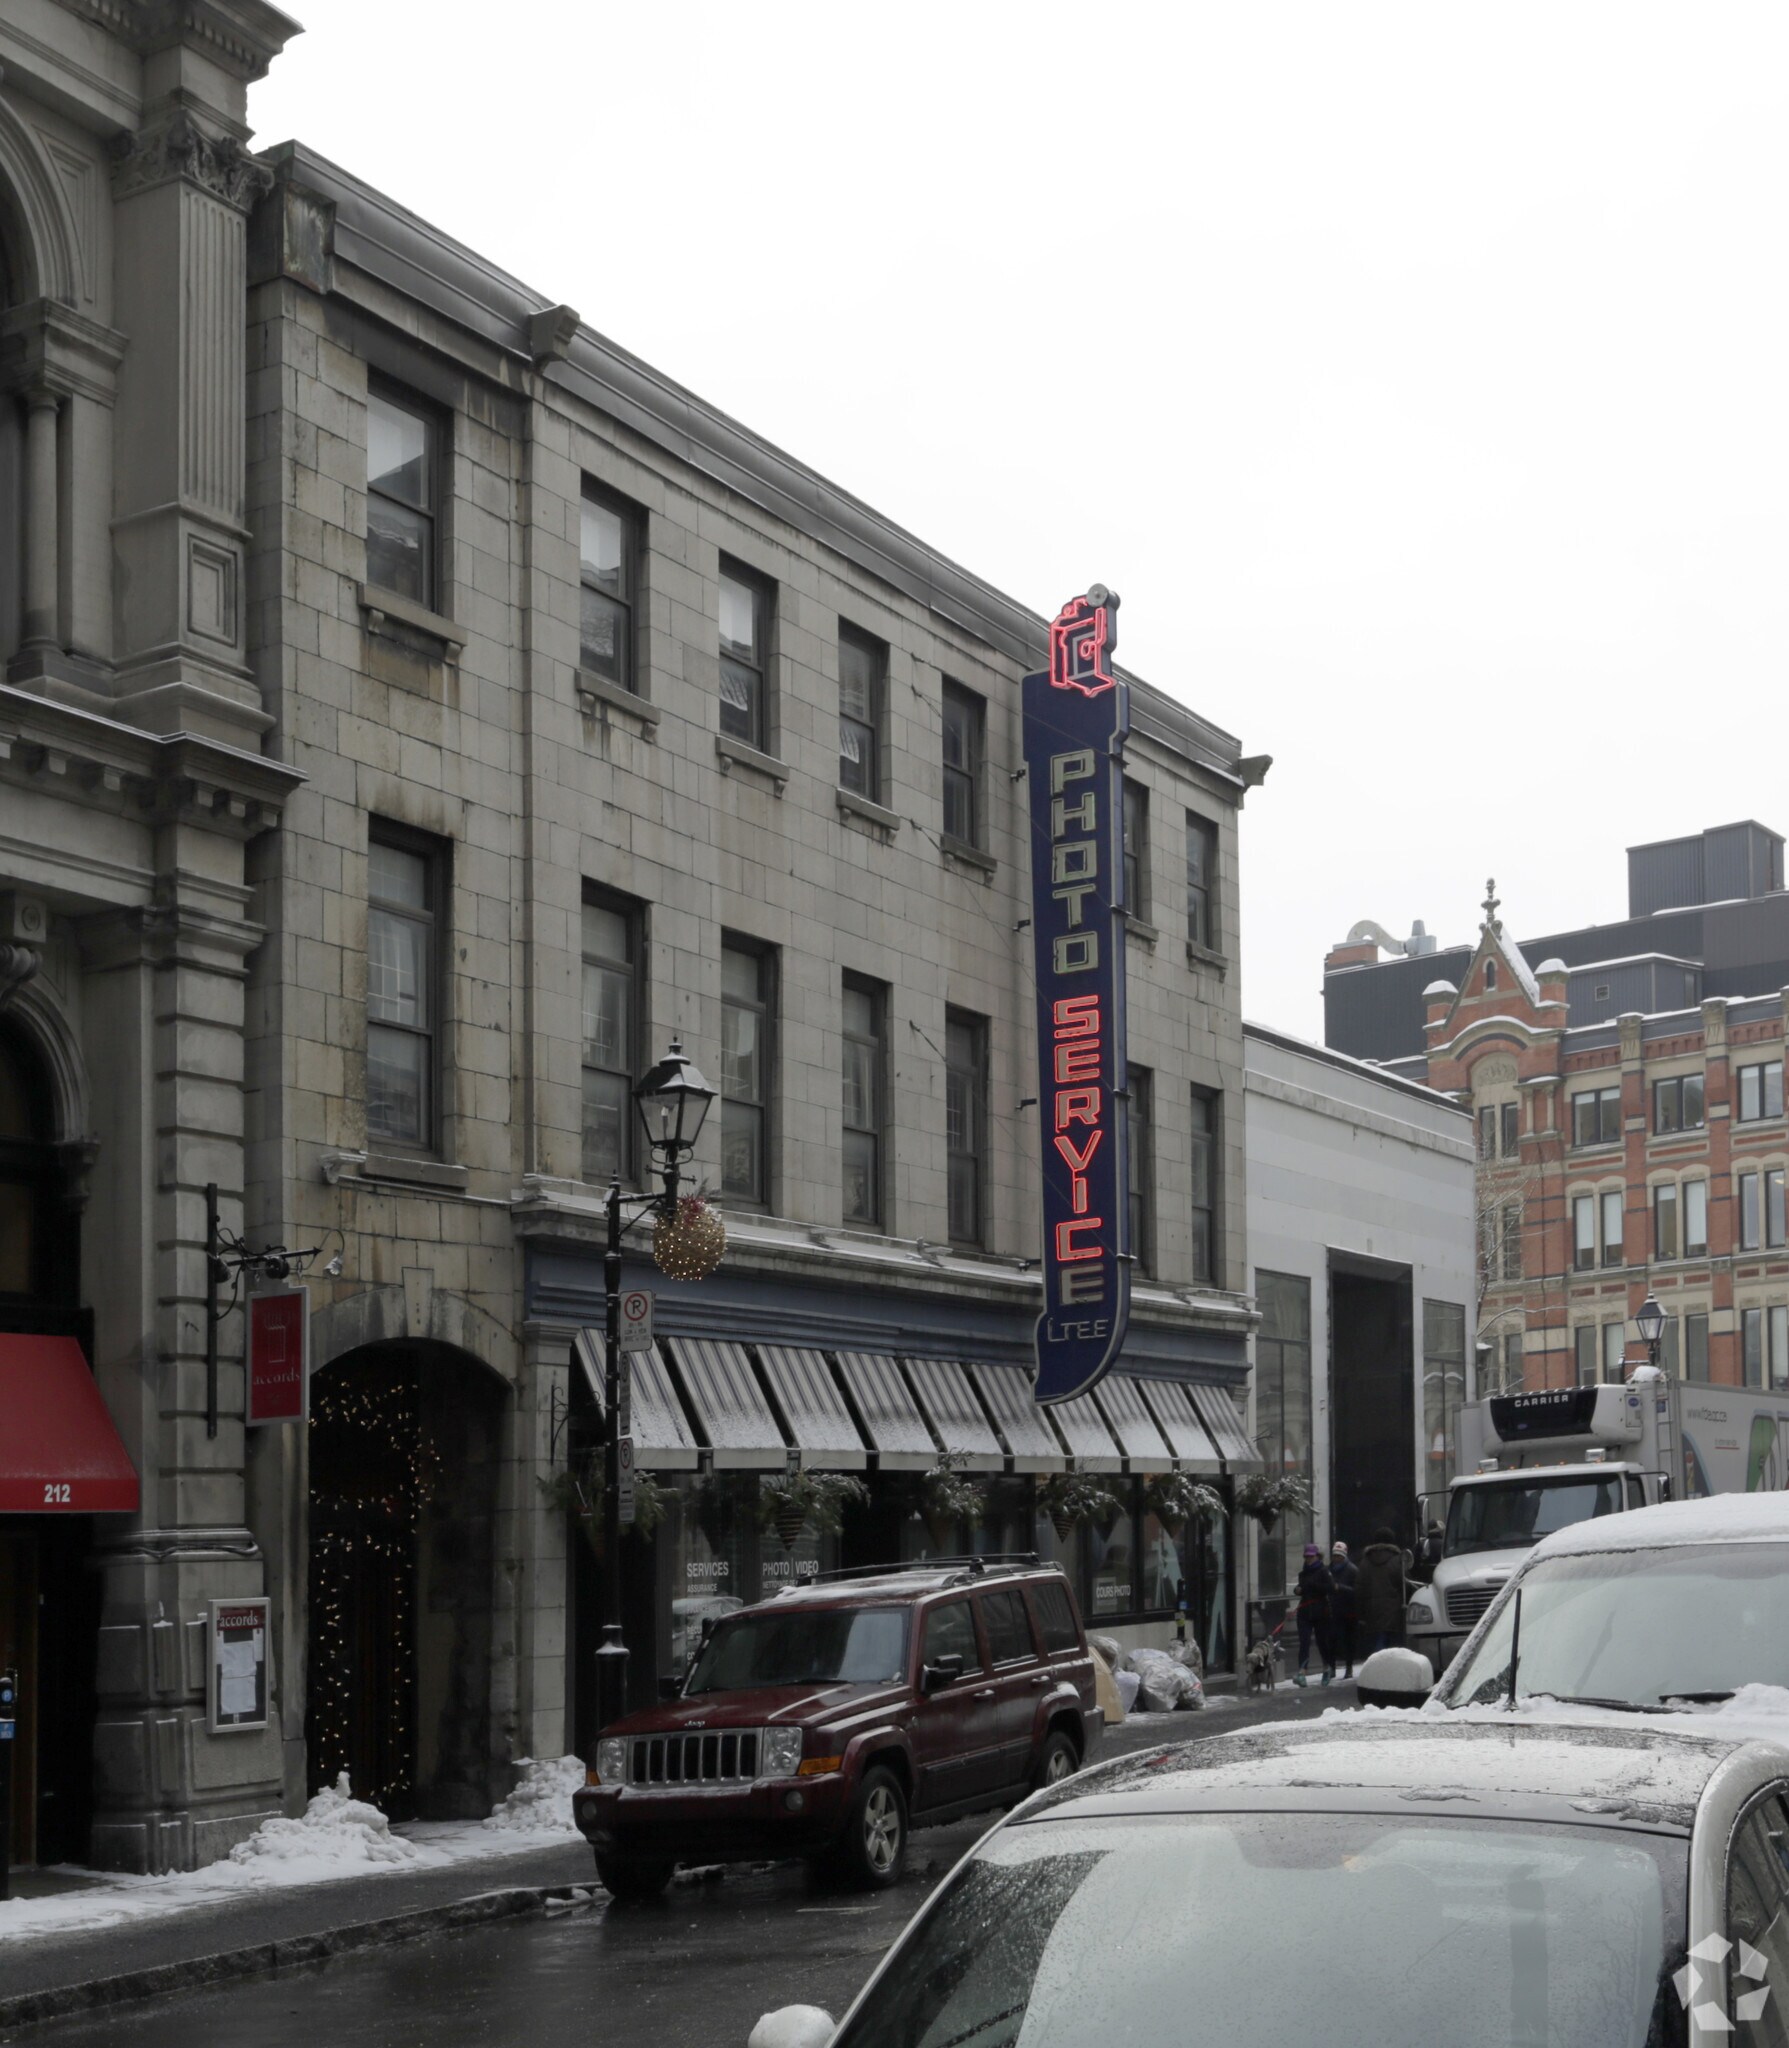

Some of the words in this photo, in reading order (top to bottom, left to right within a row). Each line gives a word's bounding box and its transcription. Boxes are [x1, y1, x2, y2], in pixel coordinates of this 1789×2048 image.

[1050, 749, 1098, 975] PHOTO
[1053, 994, 1104, 1307] SERVICE
[1514, 1395, 1569, 1408] CARRIER
[44, 1483, 71, 1503] 212
[686, 1561, 729, 1577] SERVICES
[762, 1561, 790, 1576] PHOTO
[795, 1560, 819, 1575] VIDEO
[687, 1583, 718, 1593] ASSURANCE
[1096, 1586, 1114, 1598] COURS
[1114, 1585, 1131, 1597] PHOTO
[220, 1609, 259, 1628] accords
